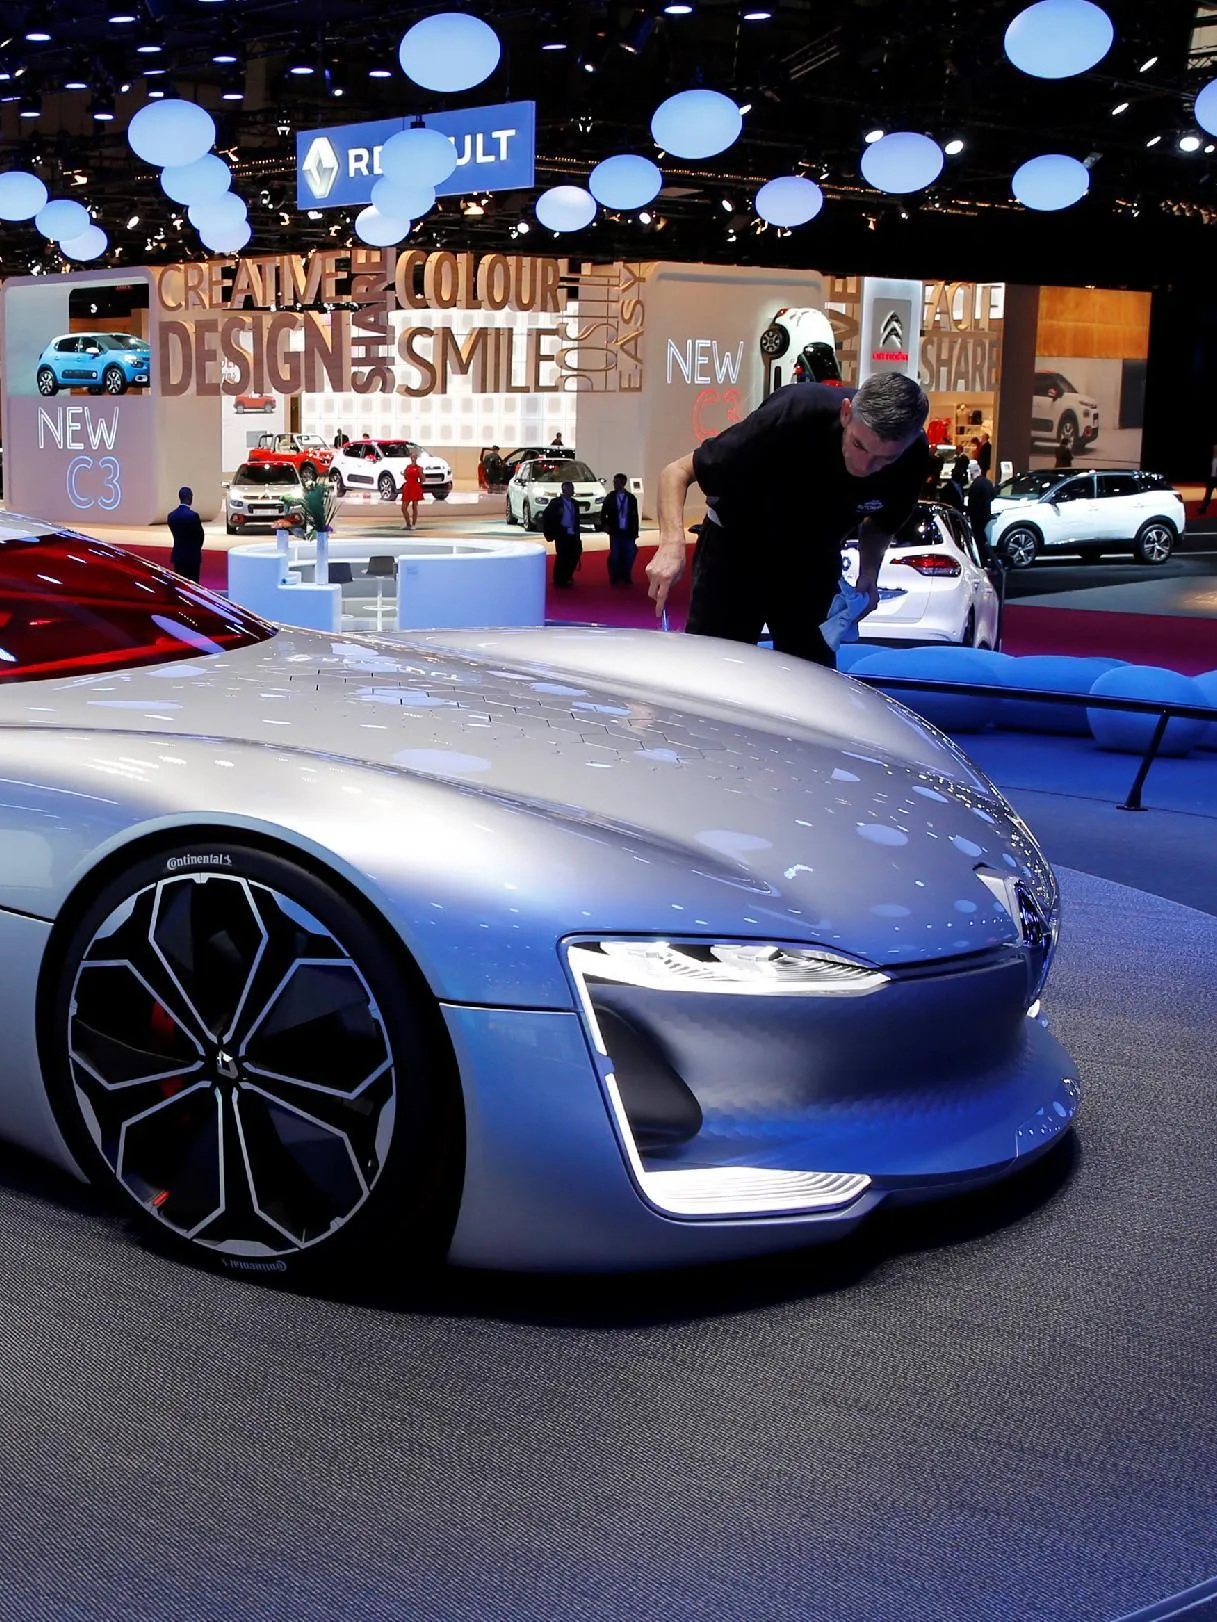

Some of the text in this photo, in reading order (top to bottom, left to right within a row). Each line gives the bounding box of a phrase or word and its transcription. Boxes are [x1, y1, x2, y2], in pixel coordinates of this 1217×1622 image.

[158, 252, 349, 312] CREATIVE
[396, 250, 561, 313] COLOUR
[351, 249, 395, 394] SHARE
[618, 263, 646, 392] EASY
[159, 311, 345, 397] DESIGN
[396, 326, 561, 398] SMILE
[666, 338, 744, 384] NEW
[921, 336, 999, 393] SHARE
[38, 406, 119, 449] NEW
[66, 455, 121, 510] C3
